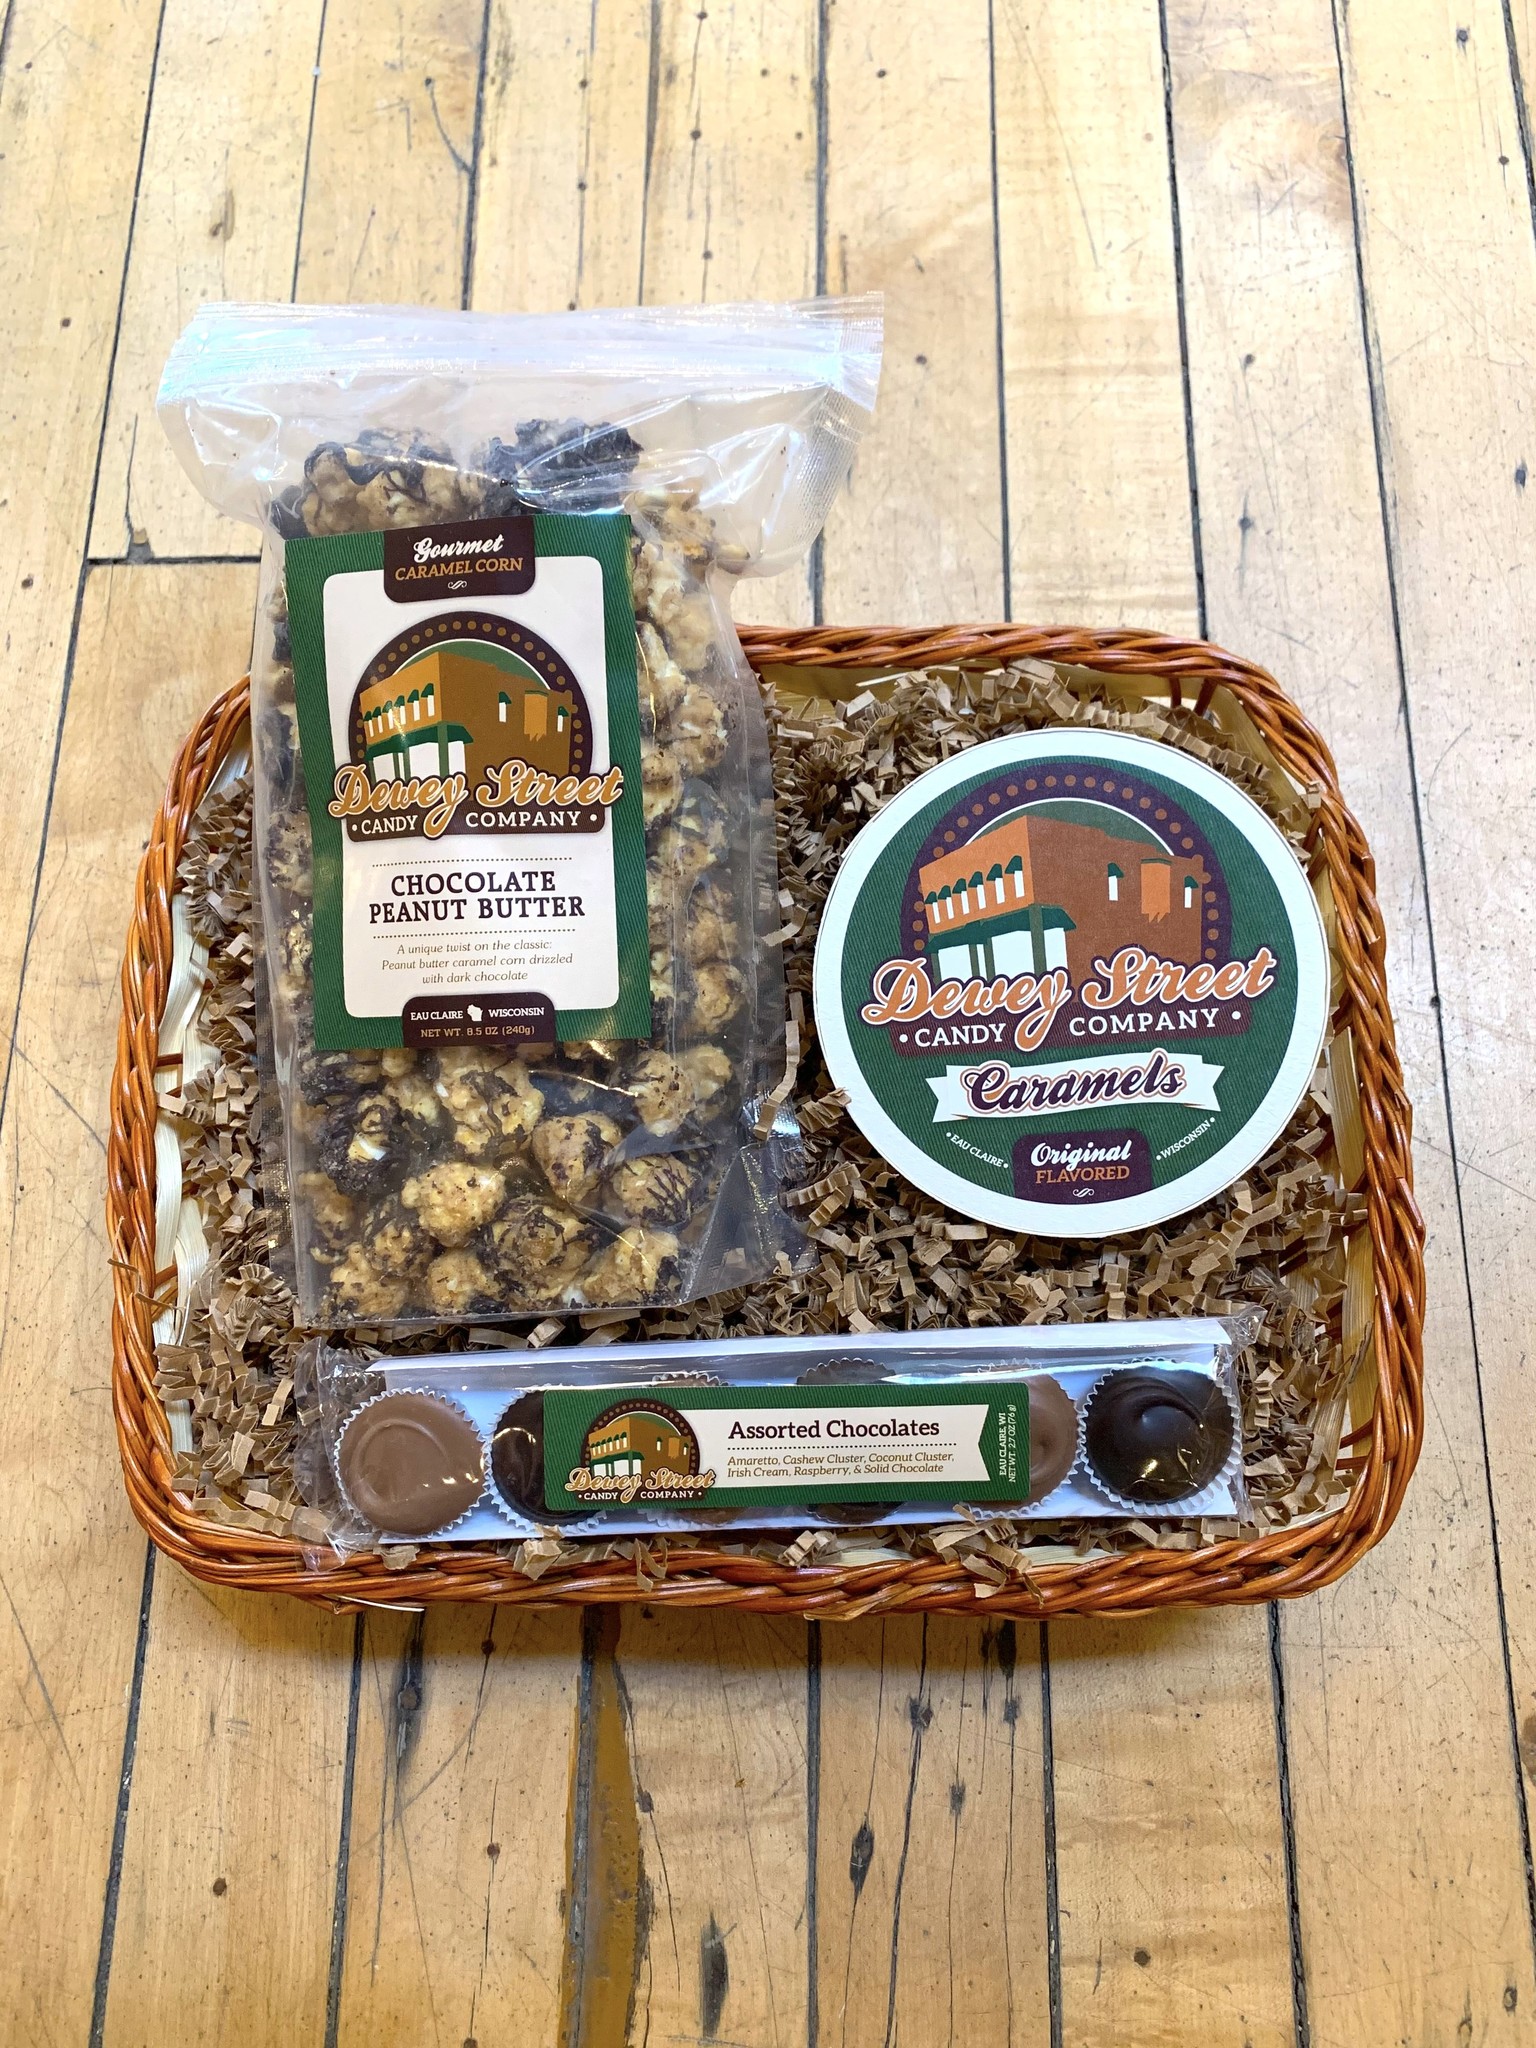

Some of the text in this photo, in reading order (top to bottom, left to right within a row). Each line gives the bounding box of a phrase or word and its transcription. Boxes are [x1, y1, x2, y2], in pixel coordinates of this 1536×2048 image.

[413, 533, 504, 563] Gourmet
[395, 557, 523, 581] CARAMEL CORN
[329, 760, 624, 838] Dewey Street
[361, 811, 581, 835] CANDY COMPANY
[391, 870, 556, 896] CHOCOLATE
[369, 896, 585, 924] PEANUT BUTTER
[397, 944, 405, 954] A
[408, 943, 443, 955] unique
[446, 942, 471, 952] twist
[474, 943, 489, 951] on
[492, 940, 511, 950] the
[382, 953, 573, 970] Peanut butter caramel corn drizzled
[422, 970, 528, 984] with dark chocolate
[862, 947, 1277, 1052] Dewey Street
[410, 1007, 545, 1020] EAU CLAIRE WISCONSIN
[420, 1025, 535, 1038] NET WT. 8.5 OZ (240g)
[914, 1008, 1219, 1048] CANDY COMPANY
[964, 1049, 1185, 1113] Caramels
[951, 1120, 1211, 1168] EAU CLAIRE WISCONSIN
[1030, 1139, 1132, 1171] Original
[1035, 1165, 1130, 1184] FLAVORED
[998, 1412, 1006, 1425] WI
[728, 1418, 940, 1439] Assorted Chocolates
[1008, 1425, 1016, 1436] OZ
[1008, 1437, 1016, 1449] 2.7
[727, 1452, 954, 1466] Amaretto, Cashew Cluster, Coconut Cluster,
[1008, 1450, 1016, 1466] WT.
[727, 1463, 944, 1478] Irish Cream, Raspberry, & Solid Chocolate
[999, 1459, 1007, 1476] EAU
[1008, 1466, 1016, 1482] NET
[565, 1467, 716, 1503] Dewey Street
[583, 1490, 694, 1500] CANDY COMPANY
